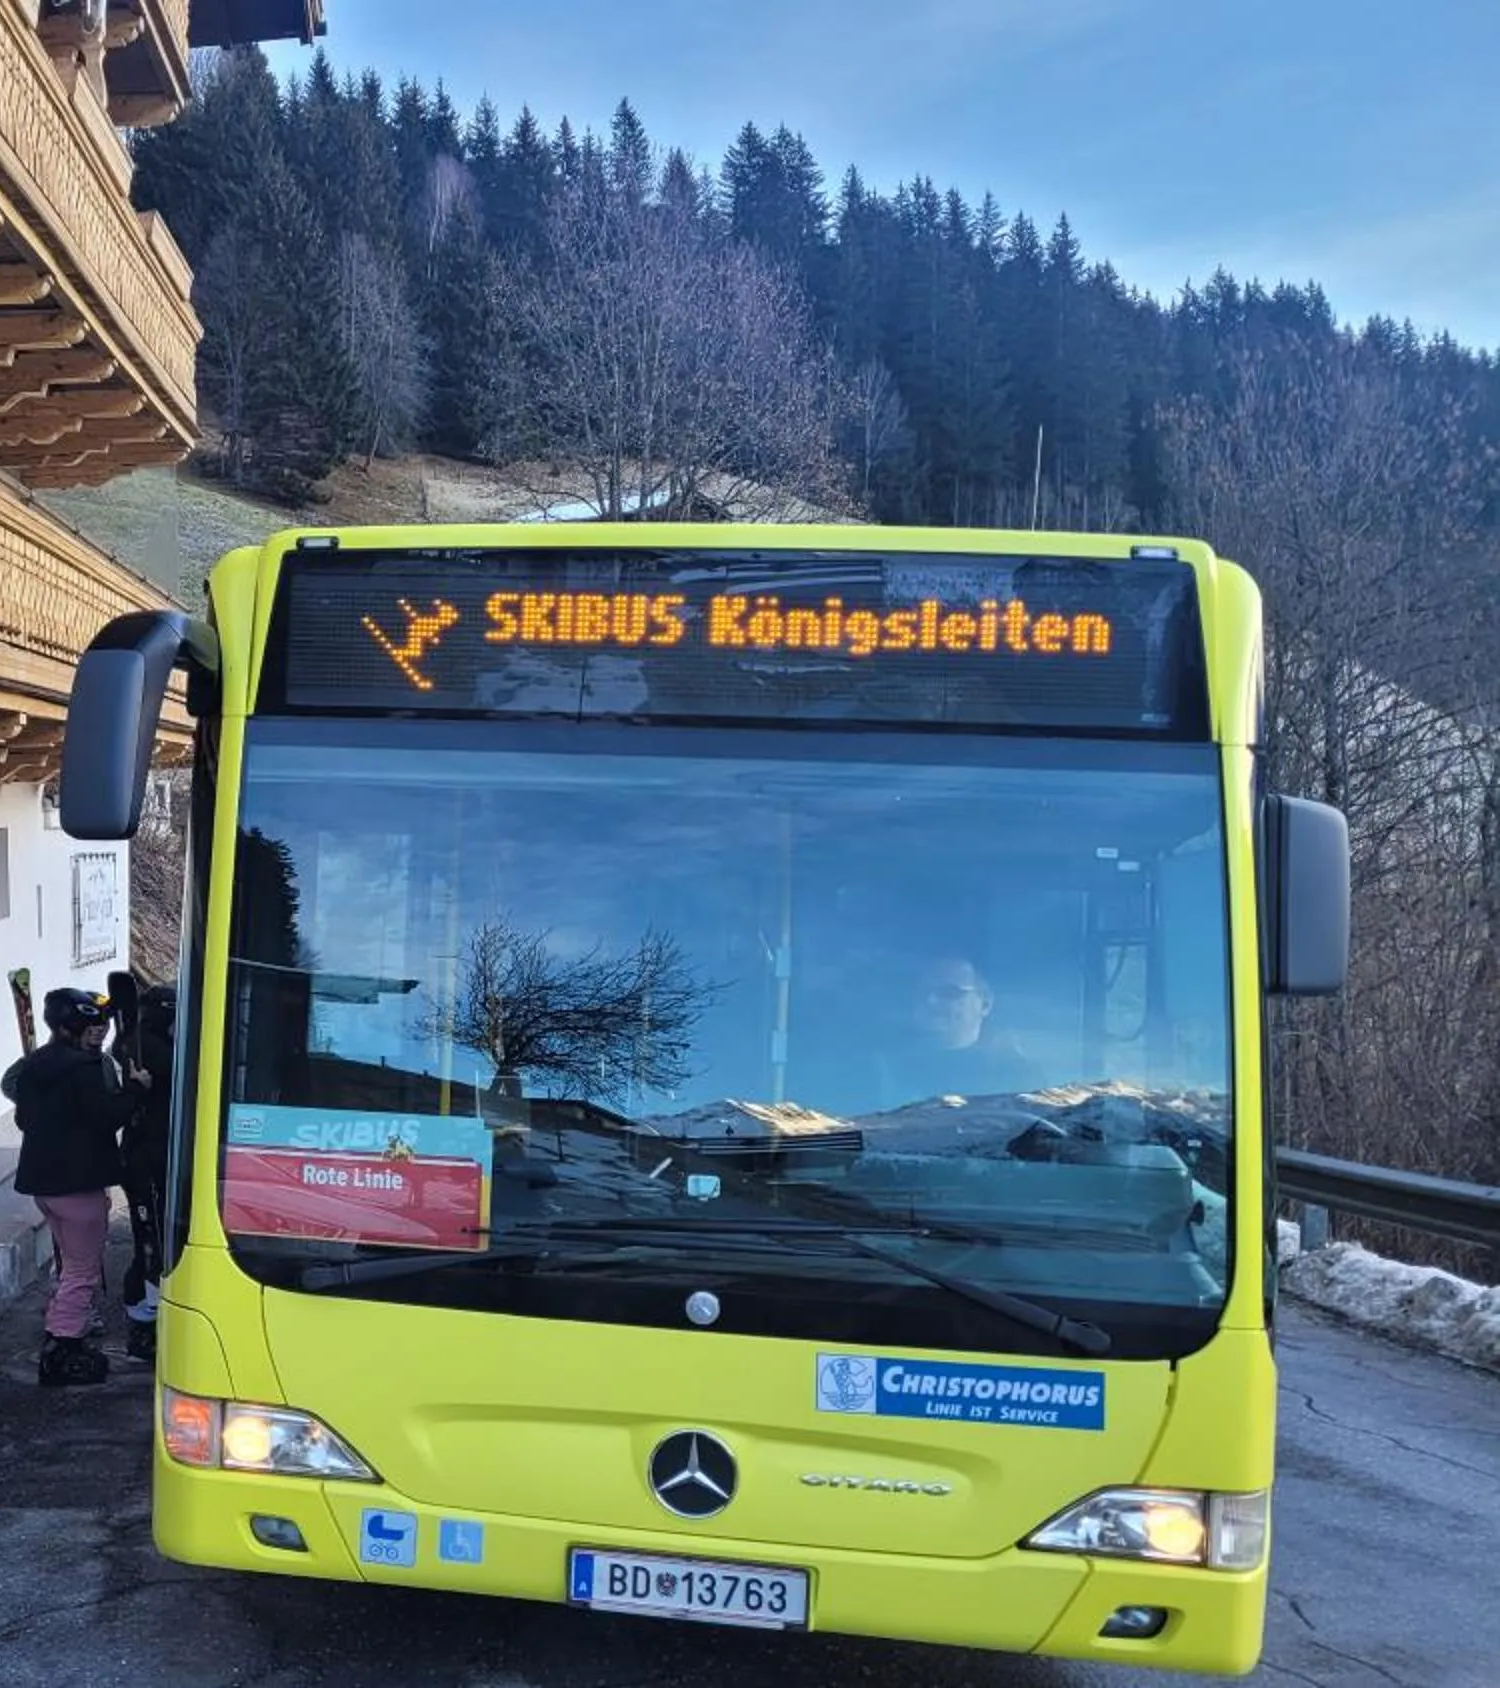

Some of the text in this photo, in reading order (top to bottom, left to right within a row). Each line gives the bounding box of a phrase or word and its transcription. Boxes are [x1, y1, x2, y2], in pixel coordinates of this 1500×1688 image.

[484, 592, 1112, 655] SKIBUS Königsleiten
[290, 1119, 421, 1150] SKIBUS
[302, 1164, 404, 1190] Rote Linie
[881, 1365, 1100, 1408] CHRISTOPHORUS
[925, 1400, 1059, 1424] LINIE IST SERVICE
[608, 1563, 788, 1614] BD 13763
